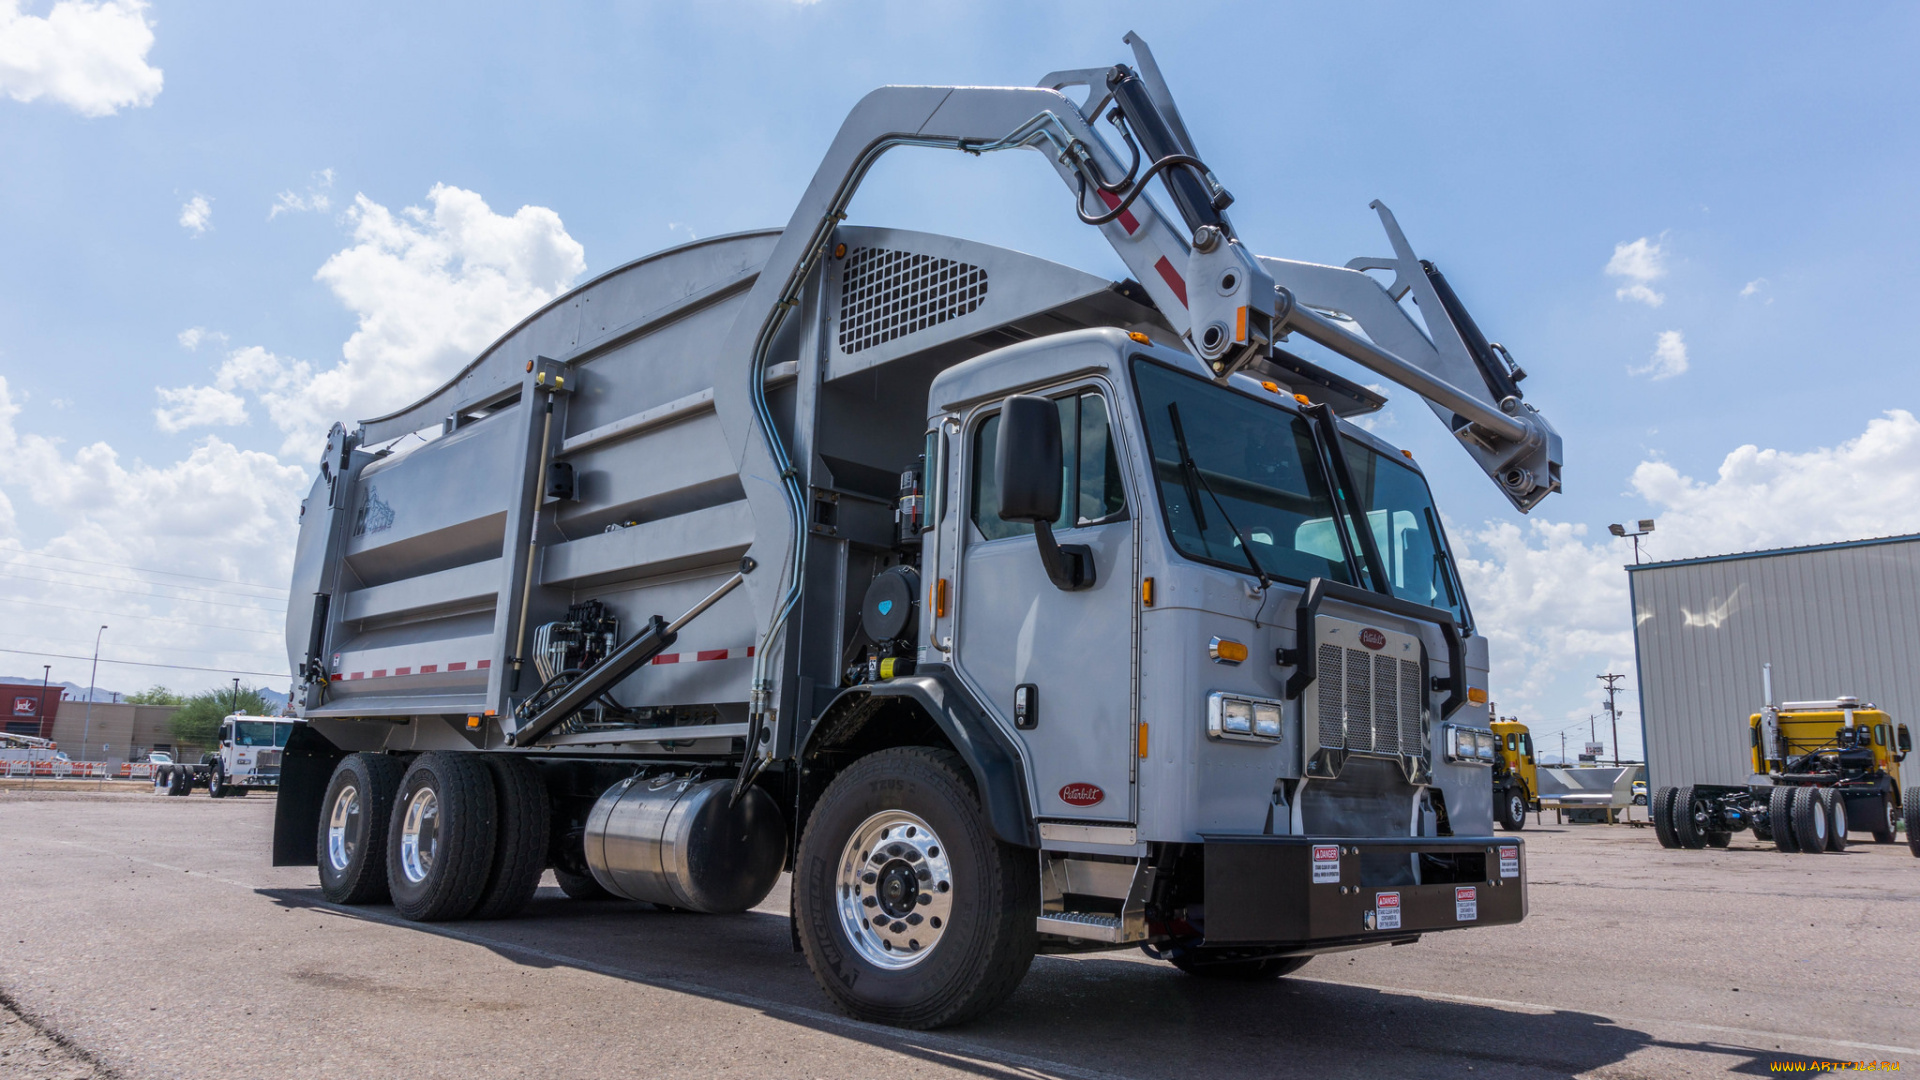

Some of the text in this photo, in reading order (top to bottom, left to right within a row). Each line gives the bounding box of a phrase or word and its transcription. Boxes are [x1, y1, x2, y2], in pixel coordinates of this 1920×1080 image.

[1063, 786, 1100, 800] Peterbilt
[1319, 849, 1336, 859] DANGER
[1382, 896, 1398, 905] DANGER
